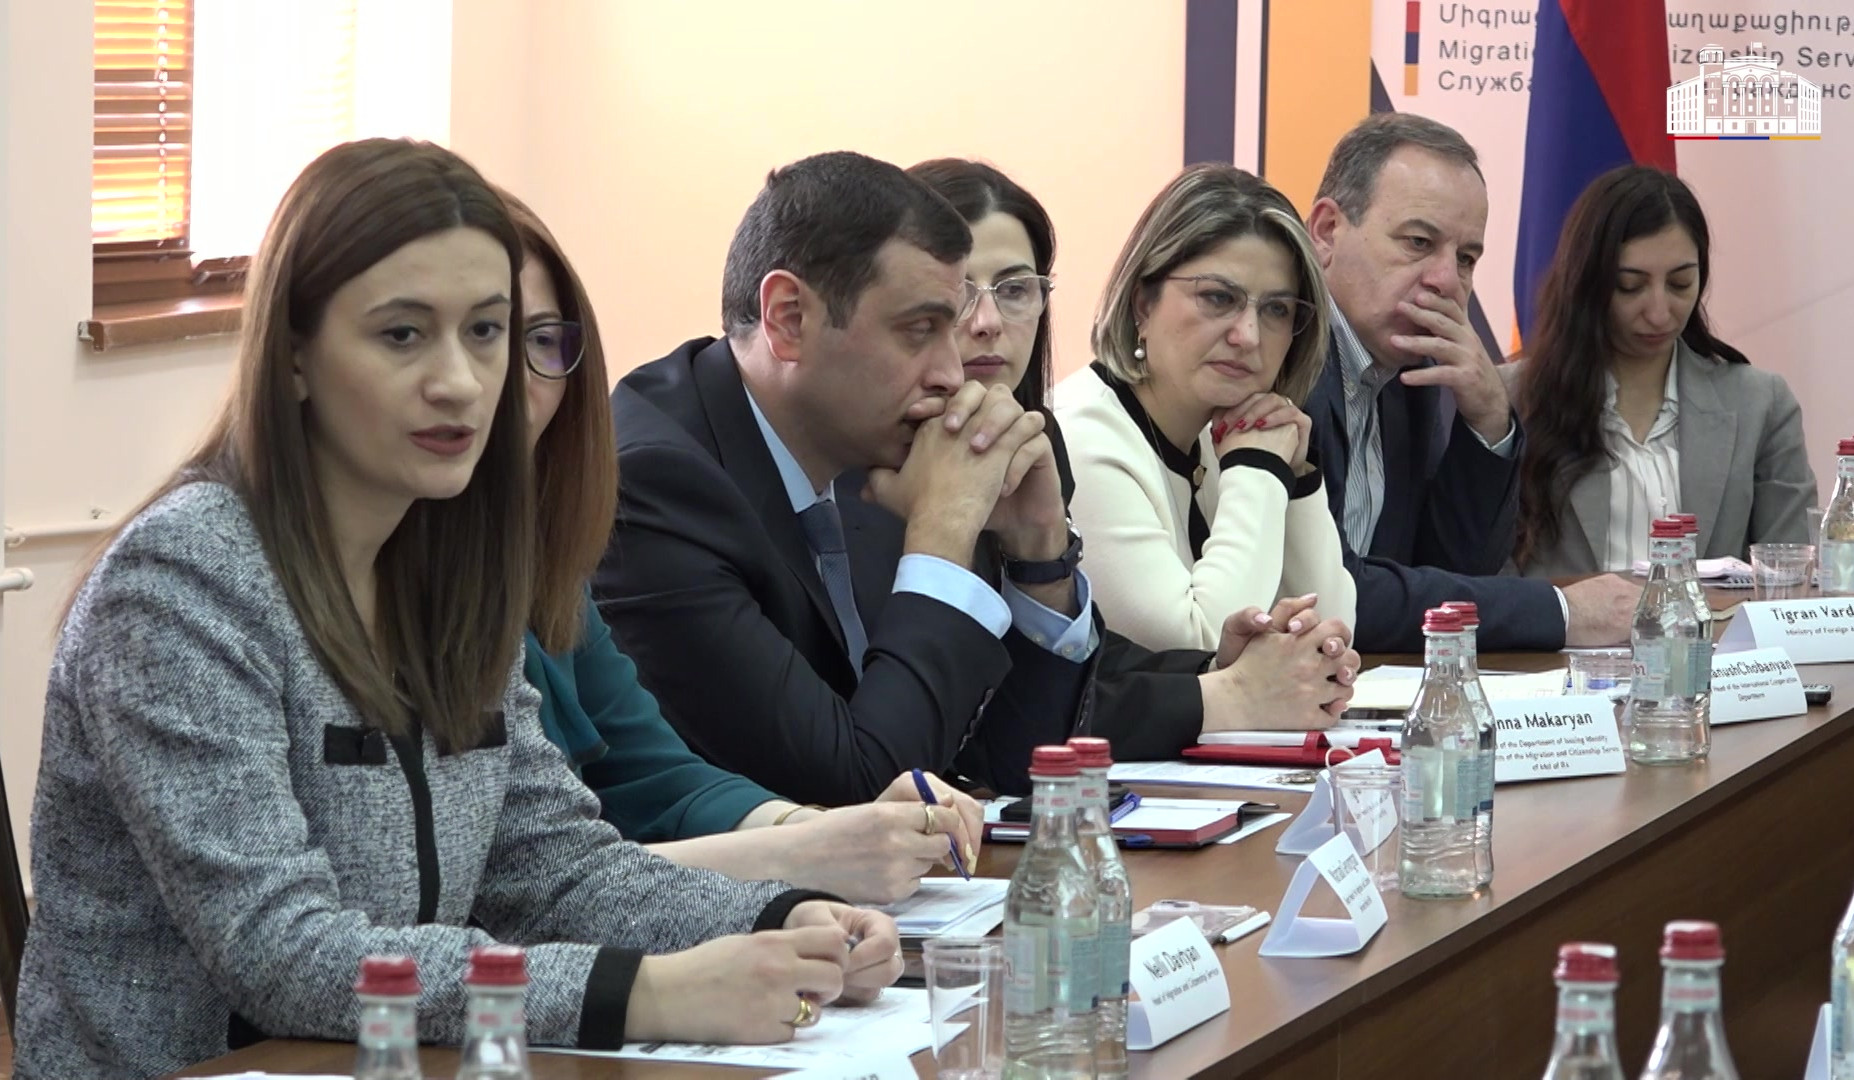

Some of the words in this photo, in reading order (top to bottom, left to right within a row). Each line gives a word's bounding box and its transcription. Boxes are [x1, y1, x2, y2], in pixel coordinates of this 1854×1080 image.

[1440, 4, 1536, 28] Միգրա
[1668, 10, 1854, 35] աղաքացիութ
[1440, 40, 1534, 65] Migrati
[1438, 70, 1532, 95] Служб
[1770, 607, 1818, 624] Tigran
[1819, 604, 1854, 618] Vard
[1785, 628, 1813, 636] Ministry
[1823, 627, 1848, 635] Foreign
[1711, 660, 1794, 679] anushChobanyan
[1496, 718, 1522, 730] nna
[1524, 712, 1593, 730] Makaryan
[1519, 739, 1555, 748] Department
[1585, 735, 1608, 743] Identity
[1525, 751, 1554, 760] Migration
[1556, 749, 1567, 757] and
[1568, 747, 1600, 757] Citizenship
